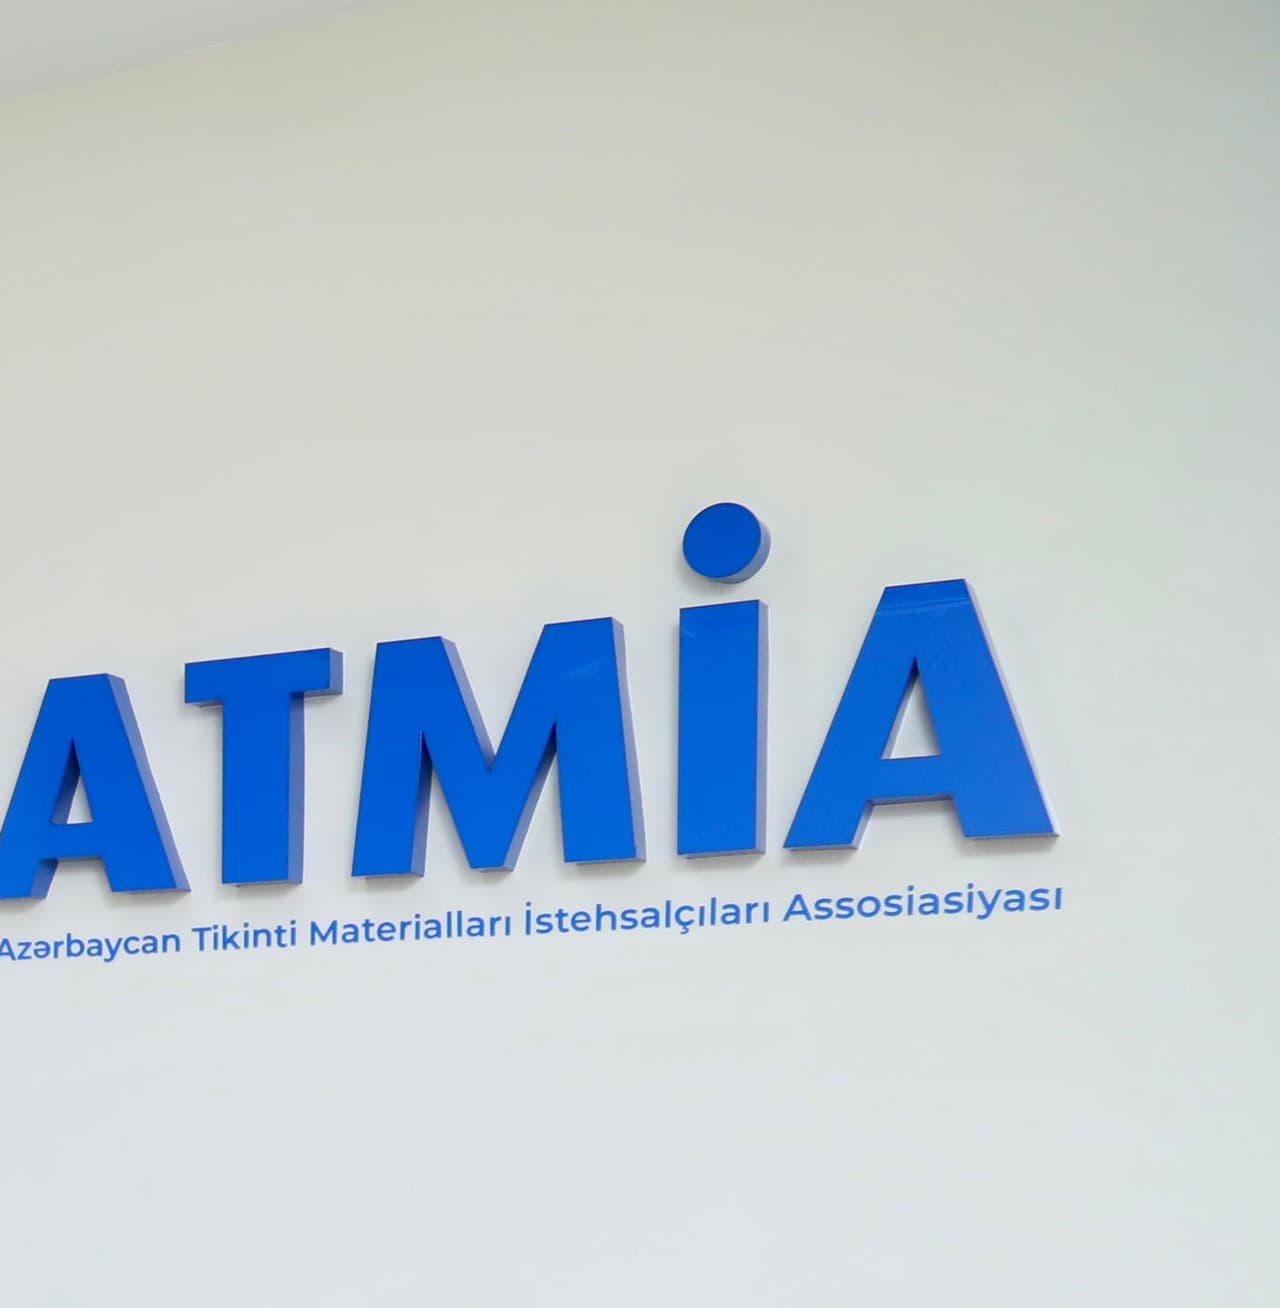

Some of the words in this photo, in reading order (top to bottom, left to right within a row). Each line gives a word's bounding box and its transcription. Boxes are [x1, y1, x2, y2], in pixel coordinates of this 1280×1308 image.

[193, 920, 297, 952] Tikinti
[309, 910, 512, 946] Materialları
[524, 897, 770, 936] İstehsalçıları
[782, 883, 1064, 924] Assosiasiyası
